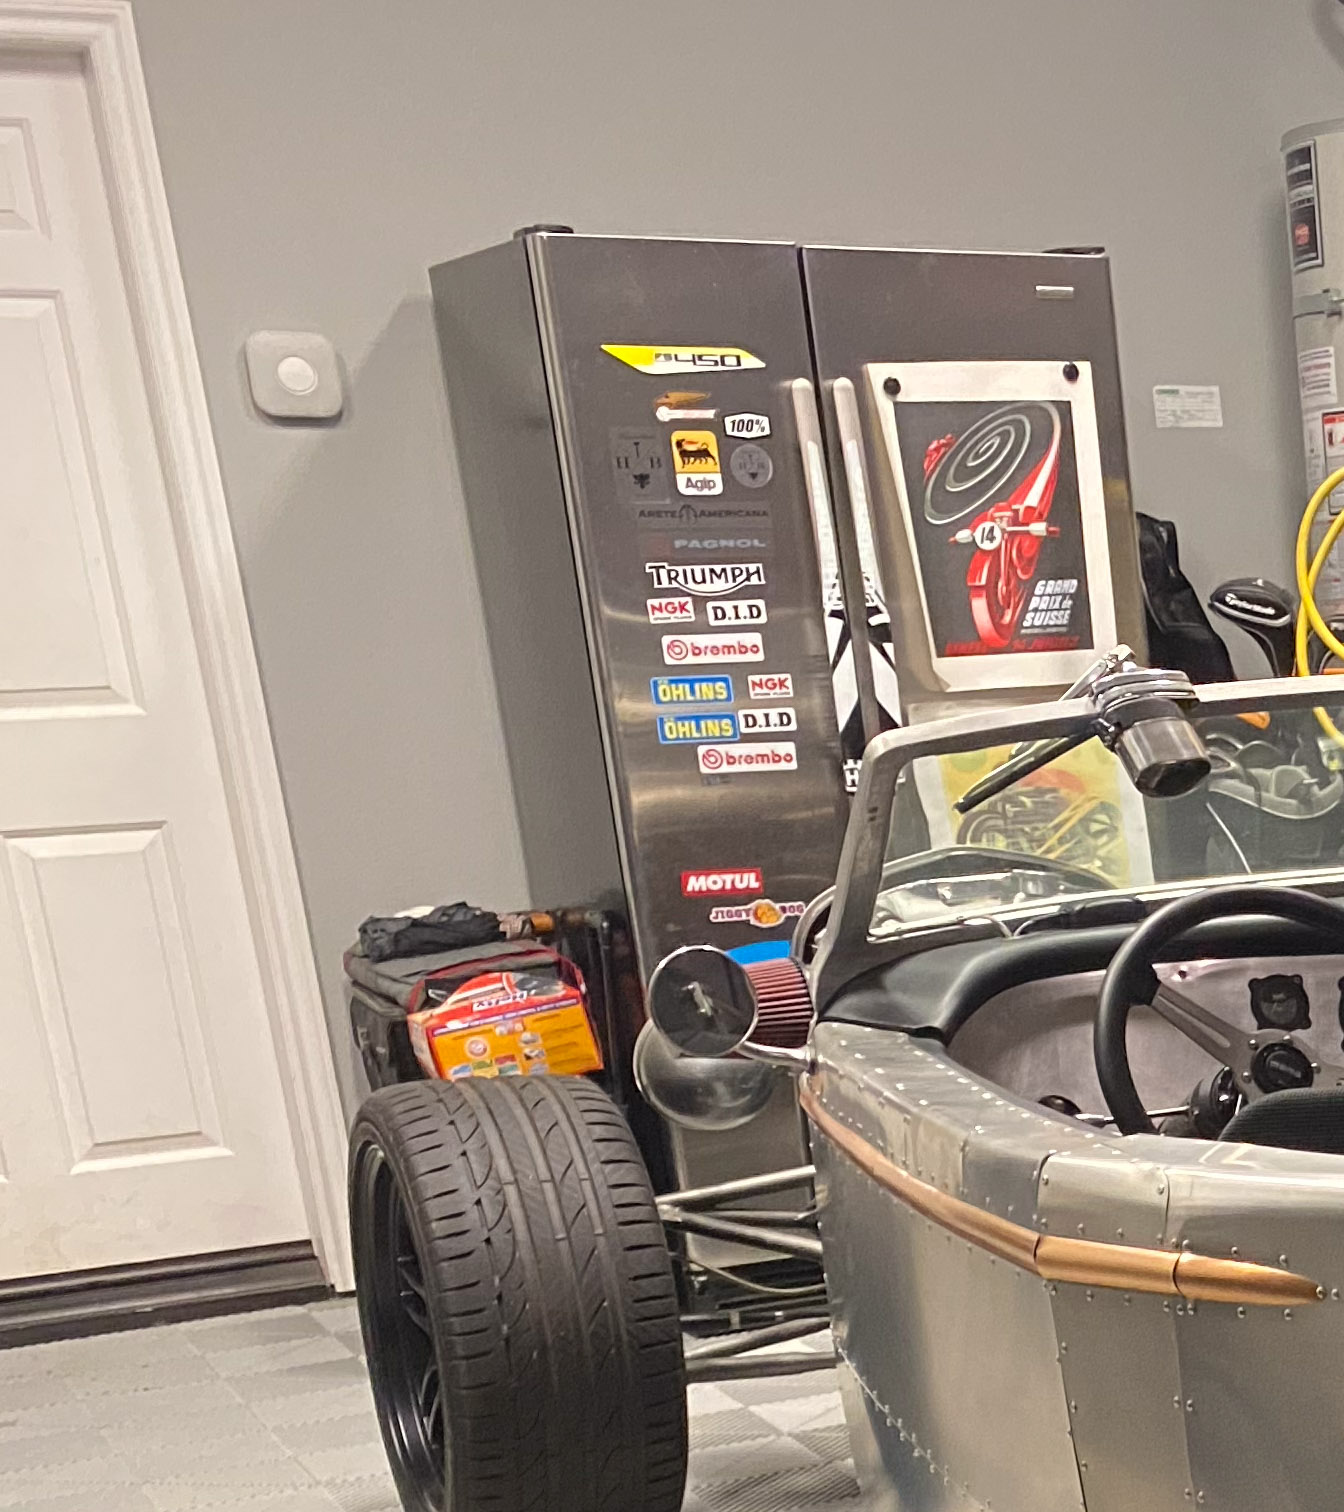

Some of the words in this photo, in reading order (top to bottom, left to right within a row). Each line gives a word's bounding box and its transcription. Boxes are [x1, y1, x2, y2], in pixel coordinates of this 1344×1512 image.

[674, 353, 742, 367] 450
[730, 419, 766, 433] 100%
[685, 477, 717, 491] Agip
[980, 525, 996, 544] 14
[673, 538, 766, 549] PAGNOL
[648, 565, 762, 592] TRIUMPH
[1034, 578, 1078, 595] GRAND
[650, 600, 691, 616] NGK
[1028, 595, 1061, 611] PRIX
[711, 604, 762, 621] D.I.D
[1022, 609, 1072, 627] SUISSE
[691, 641, 760, 657] brembo
[657, 679, 728, 703] ÖHLINS
[751, 677, 790, 691] NGK
[743, 711, 792, 729] D.I.D
[664, 717, 734, 740] ÖHLINS
[726, 750, 794, 766] brembo
[686, 872, 760, 892] MOTUL
